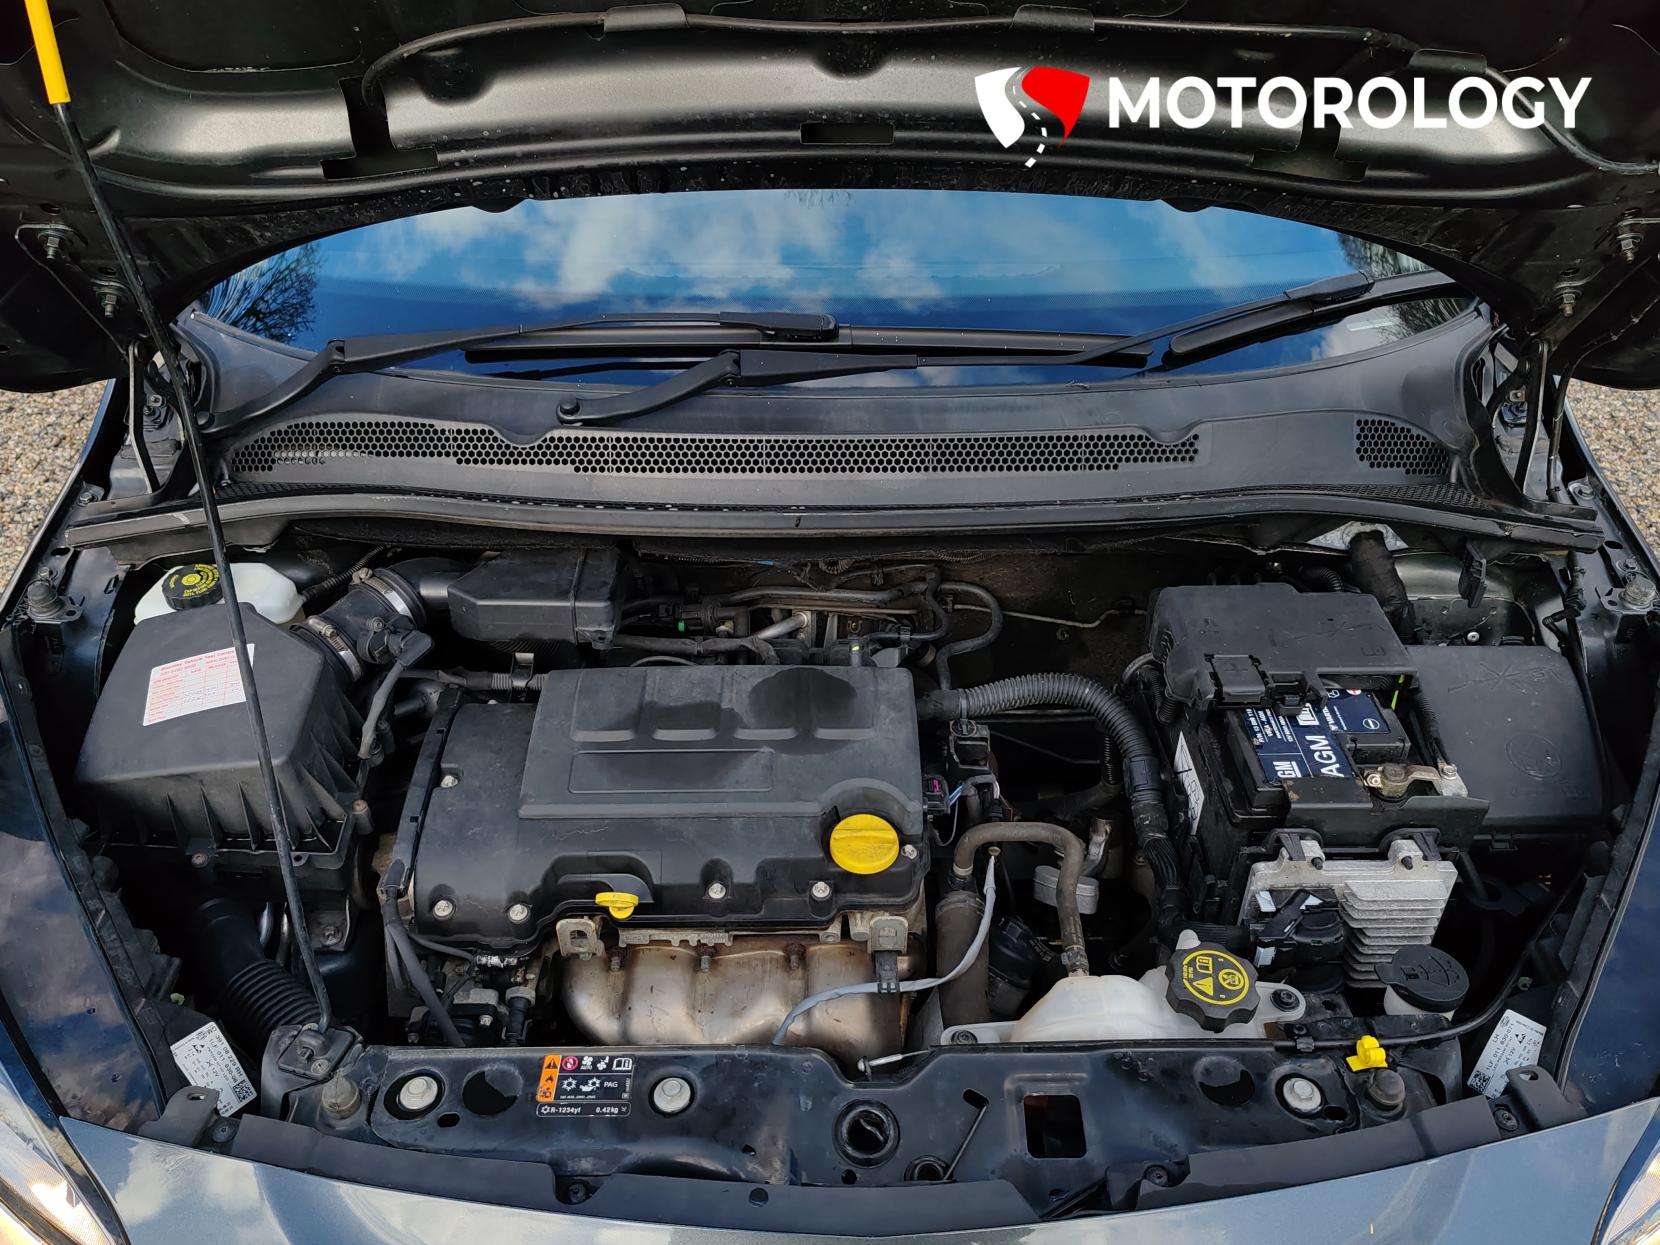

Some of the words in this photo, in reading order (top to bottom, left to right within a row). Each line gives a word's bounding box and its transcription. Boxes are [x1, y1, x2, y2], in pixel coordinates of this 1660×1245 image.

[1304, 735, 1345, 777] AGM
[1272, 761, 1297, 778] GM
[550, 1106, 581, 1114] R-1234yf
[595, 1106, 619, 1114] 0.42kg
